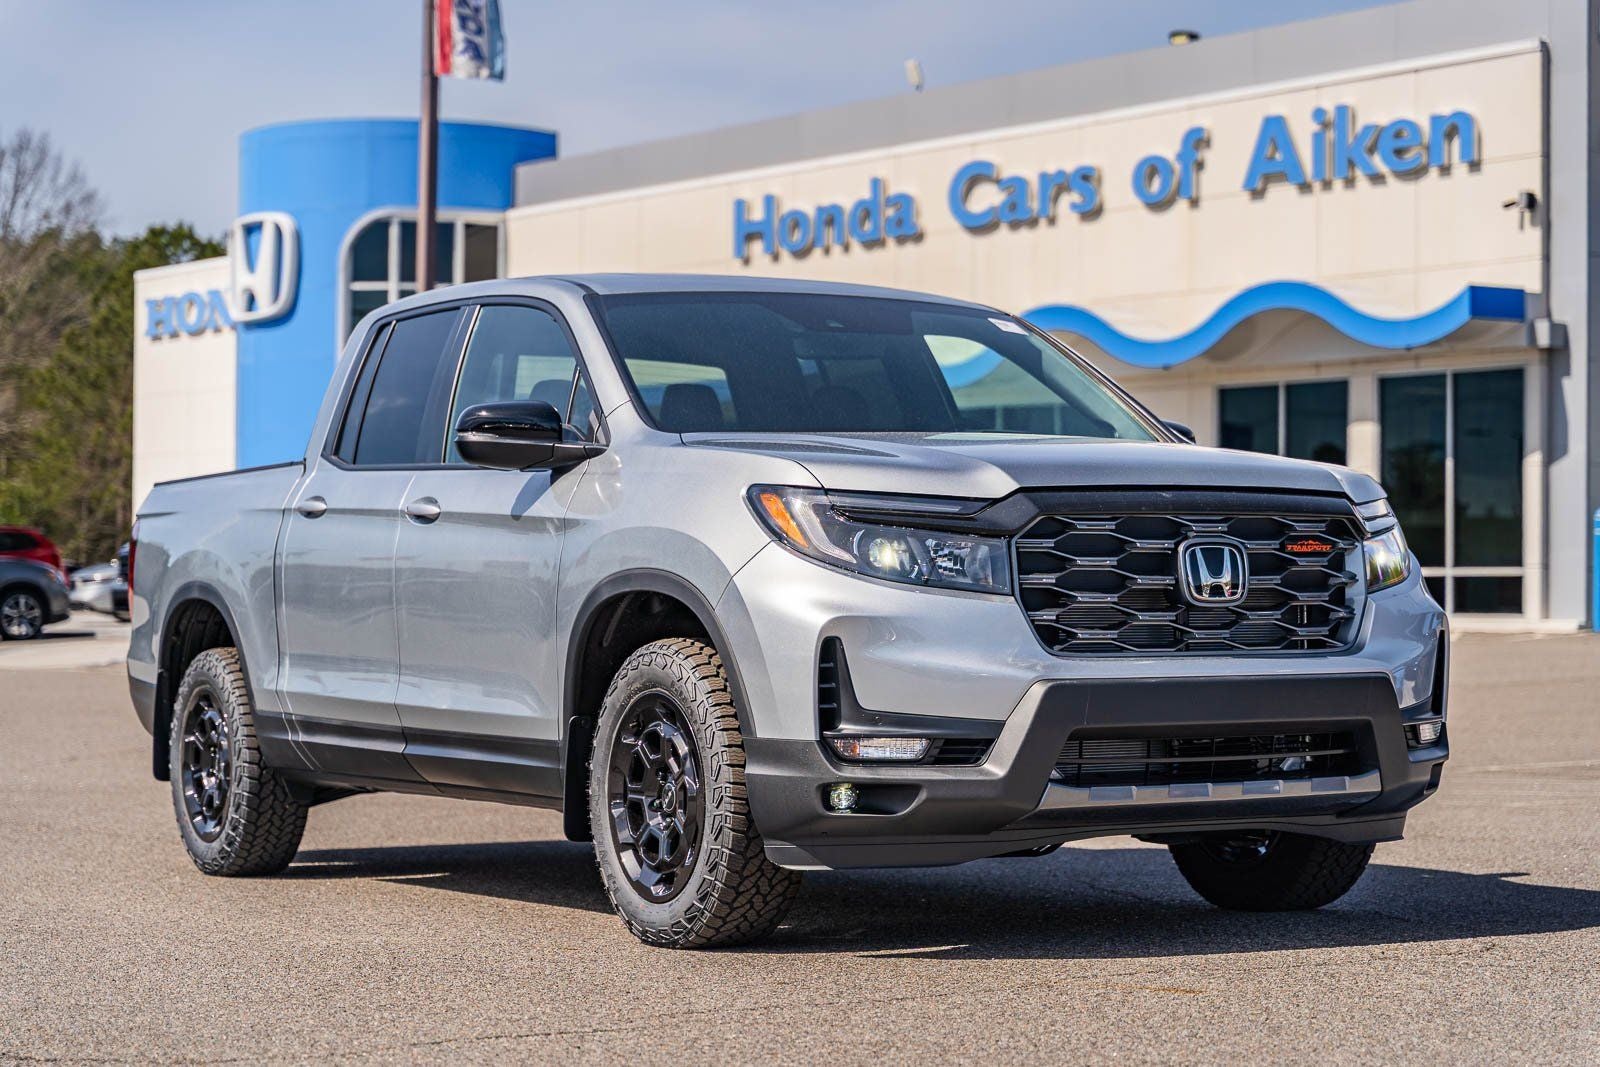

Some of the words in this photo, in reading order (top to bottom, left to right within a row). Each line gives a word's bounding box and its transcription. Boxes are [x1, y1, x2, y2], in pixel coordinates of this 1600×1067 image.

[733, 177, 919, 261] Honda
[948, 160, 1099, 229] Cars
[1132, 126, 1207, 206] of
[1242, 104, 1477, 192] Aiken
